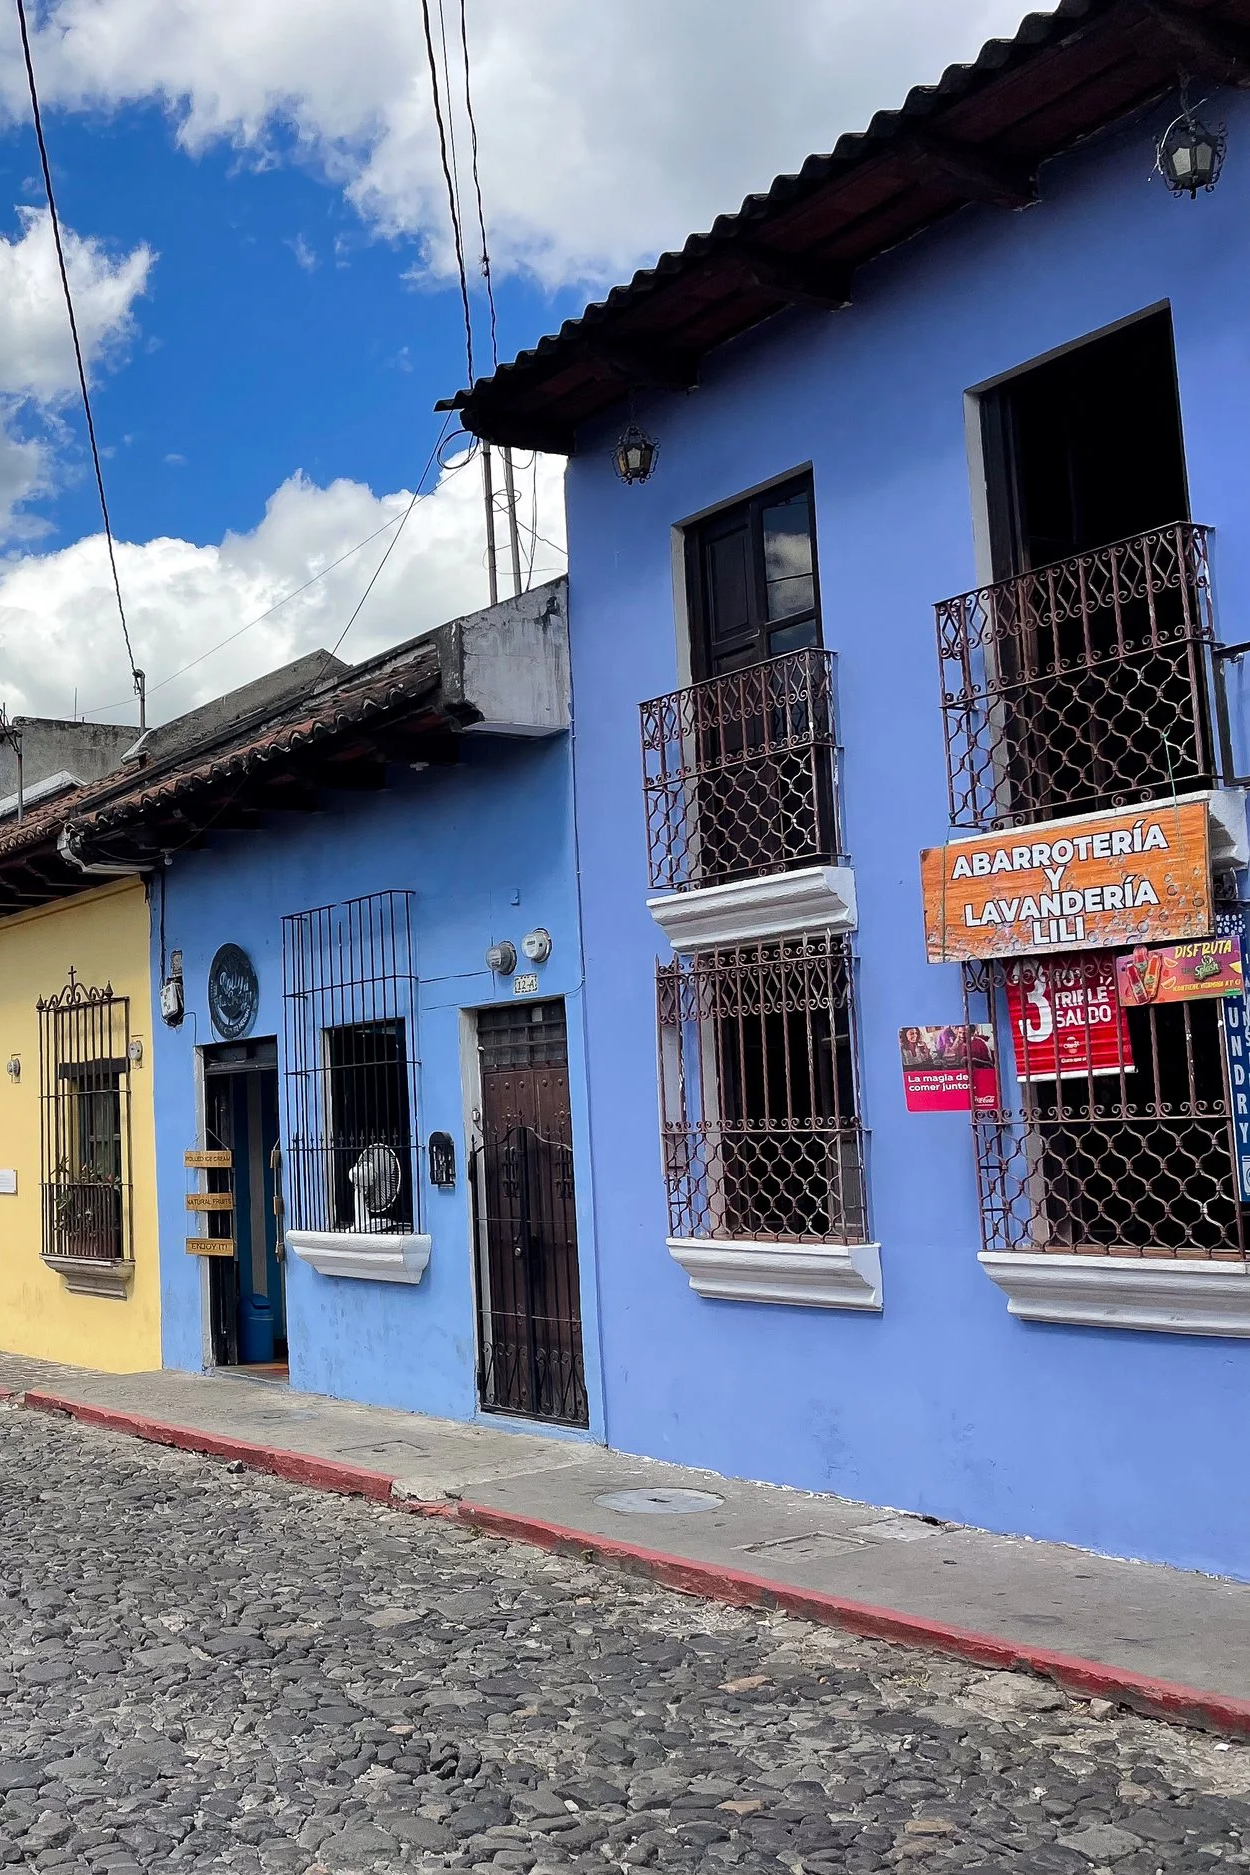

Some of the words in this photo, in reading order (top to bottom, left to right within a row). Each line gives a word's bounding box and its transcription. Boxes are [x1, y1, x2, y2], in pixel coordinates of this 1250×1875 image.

[951, 819, 1169, 880] ABARROTERÍA
[1043, 866, 1066, 891] Y
[964, 875, 1159, 927] LAVANDERÍA
[1032, 917, 1085, 945] LILI
[1175, 940, 1232, 959] DISFRUTA
[517, 979, 535, 991] 12-A
[1055, 986, 1110, 1008] TRIPLE
[1056, 1005, 1112, 1028] SALDO
[908, 1075, 921, 1083] La
[923, 1073, 954, 1083] magia
[956, 1073, 969, 1081] de
[909, 1084, 940, 1092] comer
[187, 1198, 211, 1206] NATURAL
[213, 1198, 232, 1206] FRUITS
[191, 1242, 217, 1250] ENJOY
